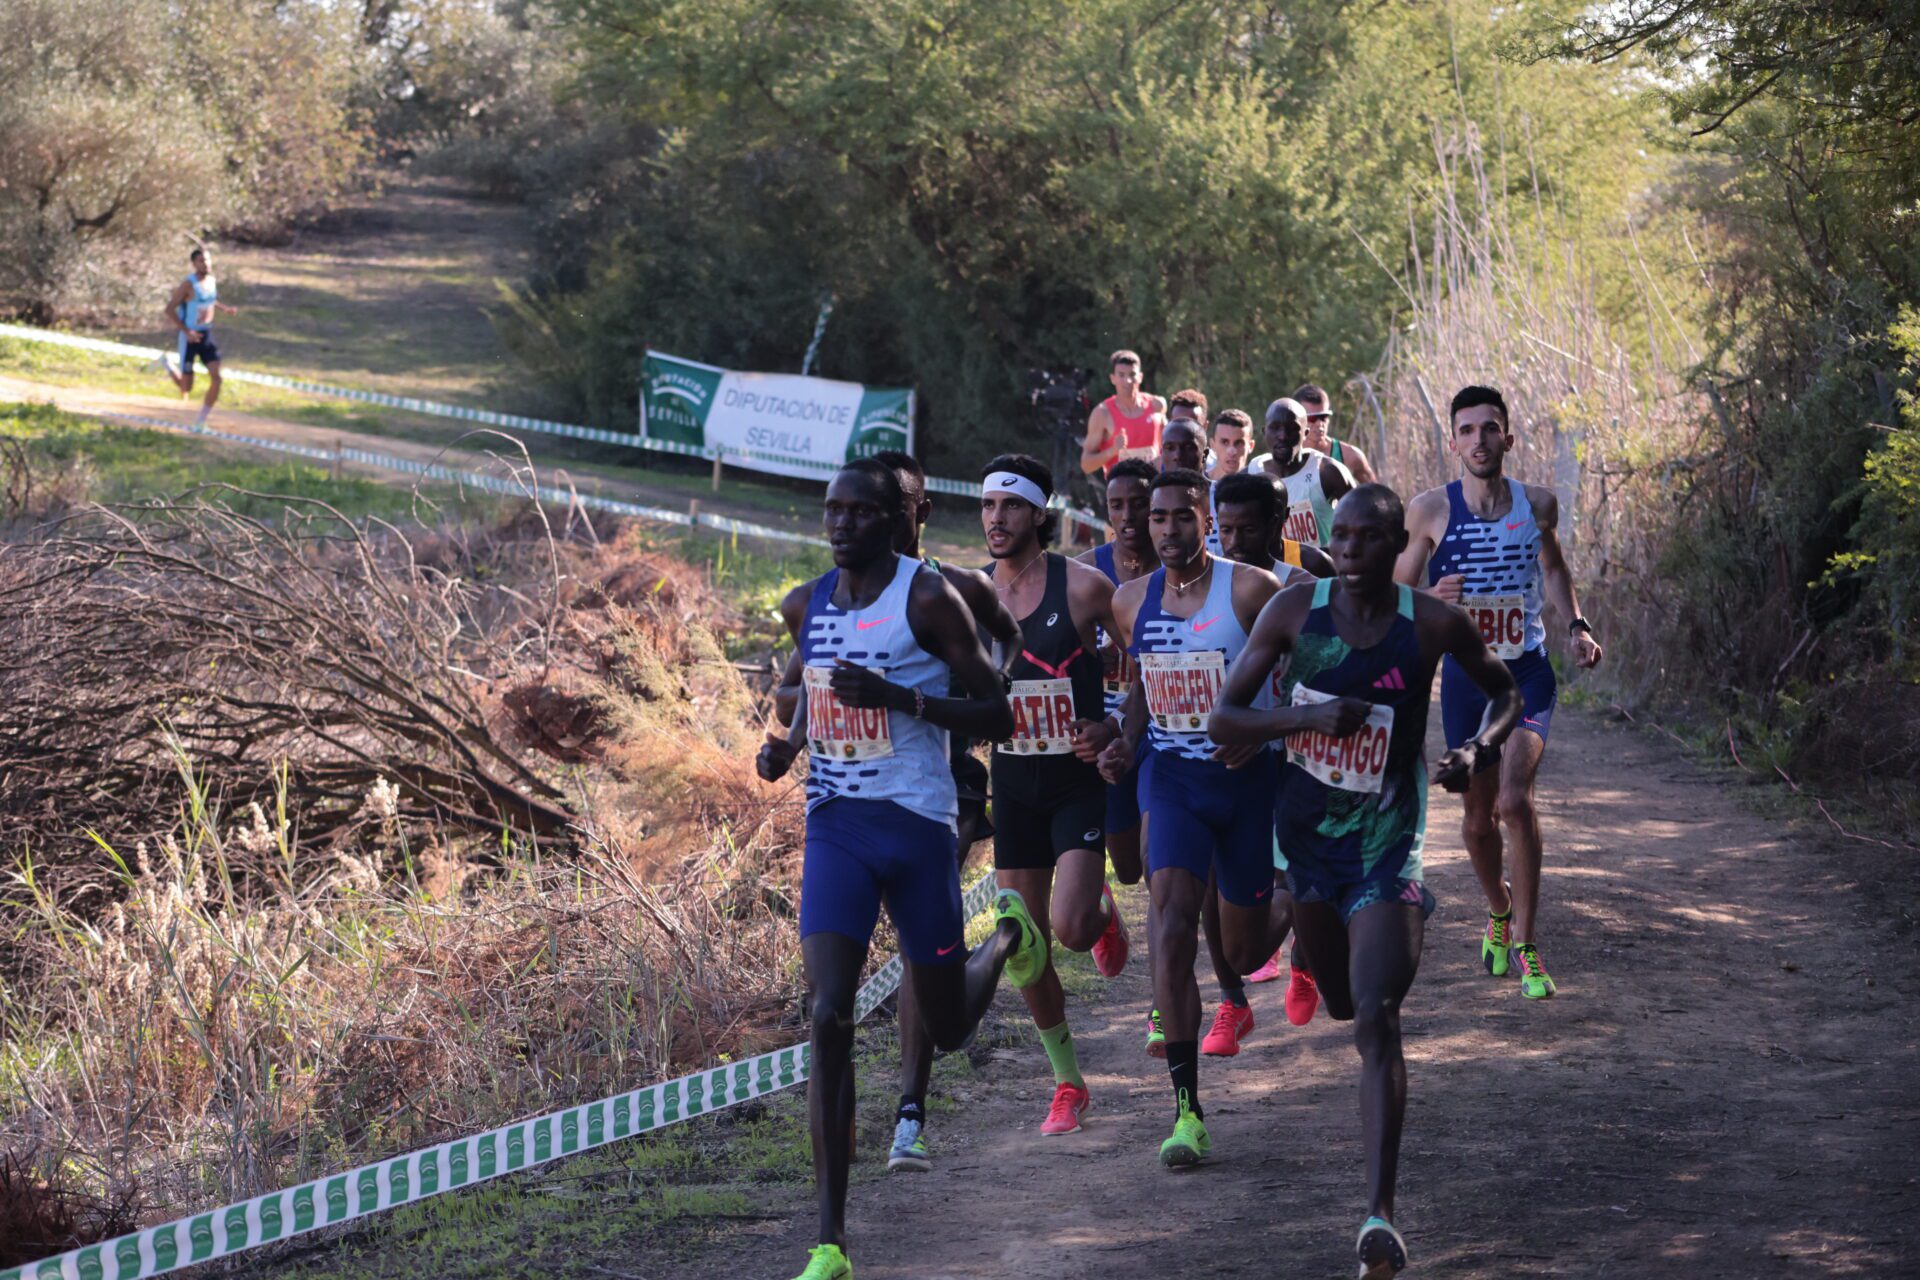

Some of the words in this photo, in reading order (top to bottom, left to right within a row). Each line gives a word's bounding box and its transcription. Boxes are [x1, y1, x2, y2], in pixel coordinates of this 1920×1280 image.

[649, 404, 697, 428] SEVILLA
[724, 388, 826, 422] DIPUTACIÓN
[827, 405, 850, 426] DE
[745, 426, 811, 454] SEVILLA
